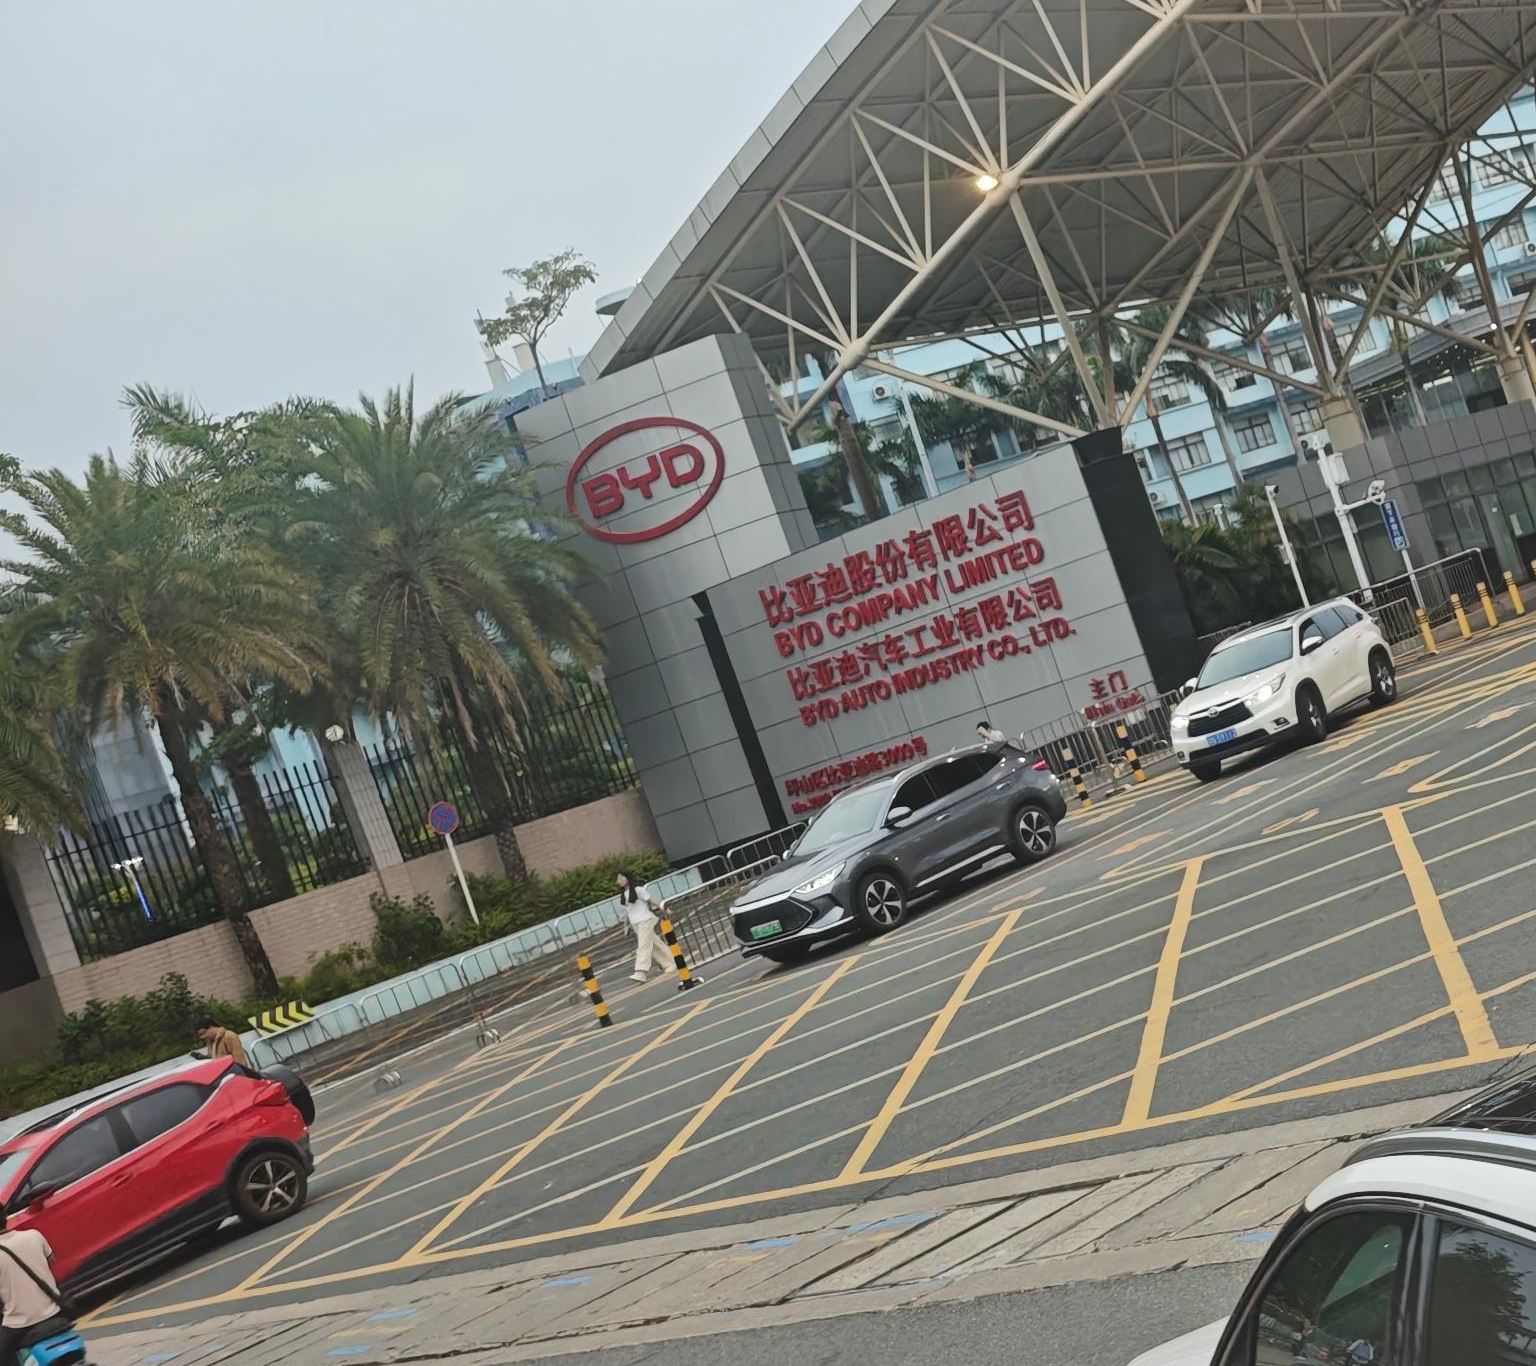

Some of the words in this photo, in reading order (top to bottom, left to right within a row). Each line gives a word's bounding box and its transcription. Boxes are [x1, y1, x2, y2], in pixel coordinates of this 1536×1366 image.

[582, 444, 704, 518] BYD
[758, 490, 1034, 627] 比亚迪股份有限公司
[774, 621, 824, 657] BYD
[826, 574, 939, 637] COMPANY
[943, 538, 1045, 594] LIMITED
[787, 577, 1062, 701] 比亚迪汽车工业有限公司
[800, 697, 840, 726] BYD
[840, 680, 892, 713] AUTO
[892, 644, 985, 695] INDUSTRY
[1029, 617, 1077, 648] LTD.
[1088, 669, 1128, 700] 主门
